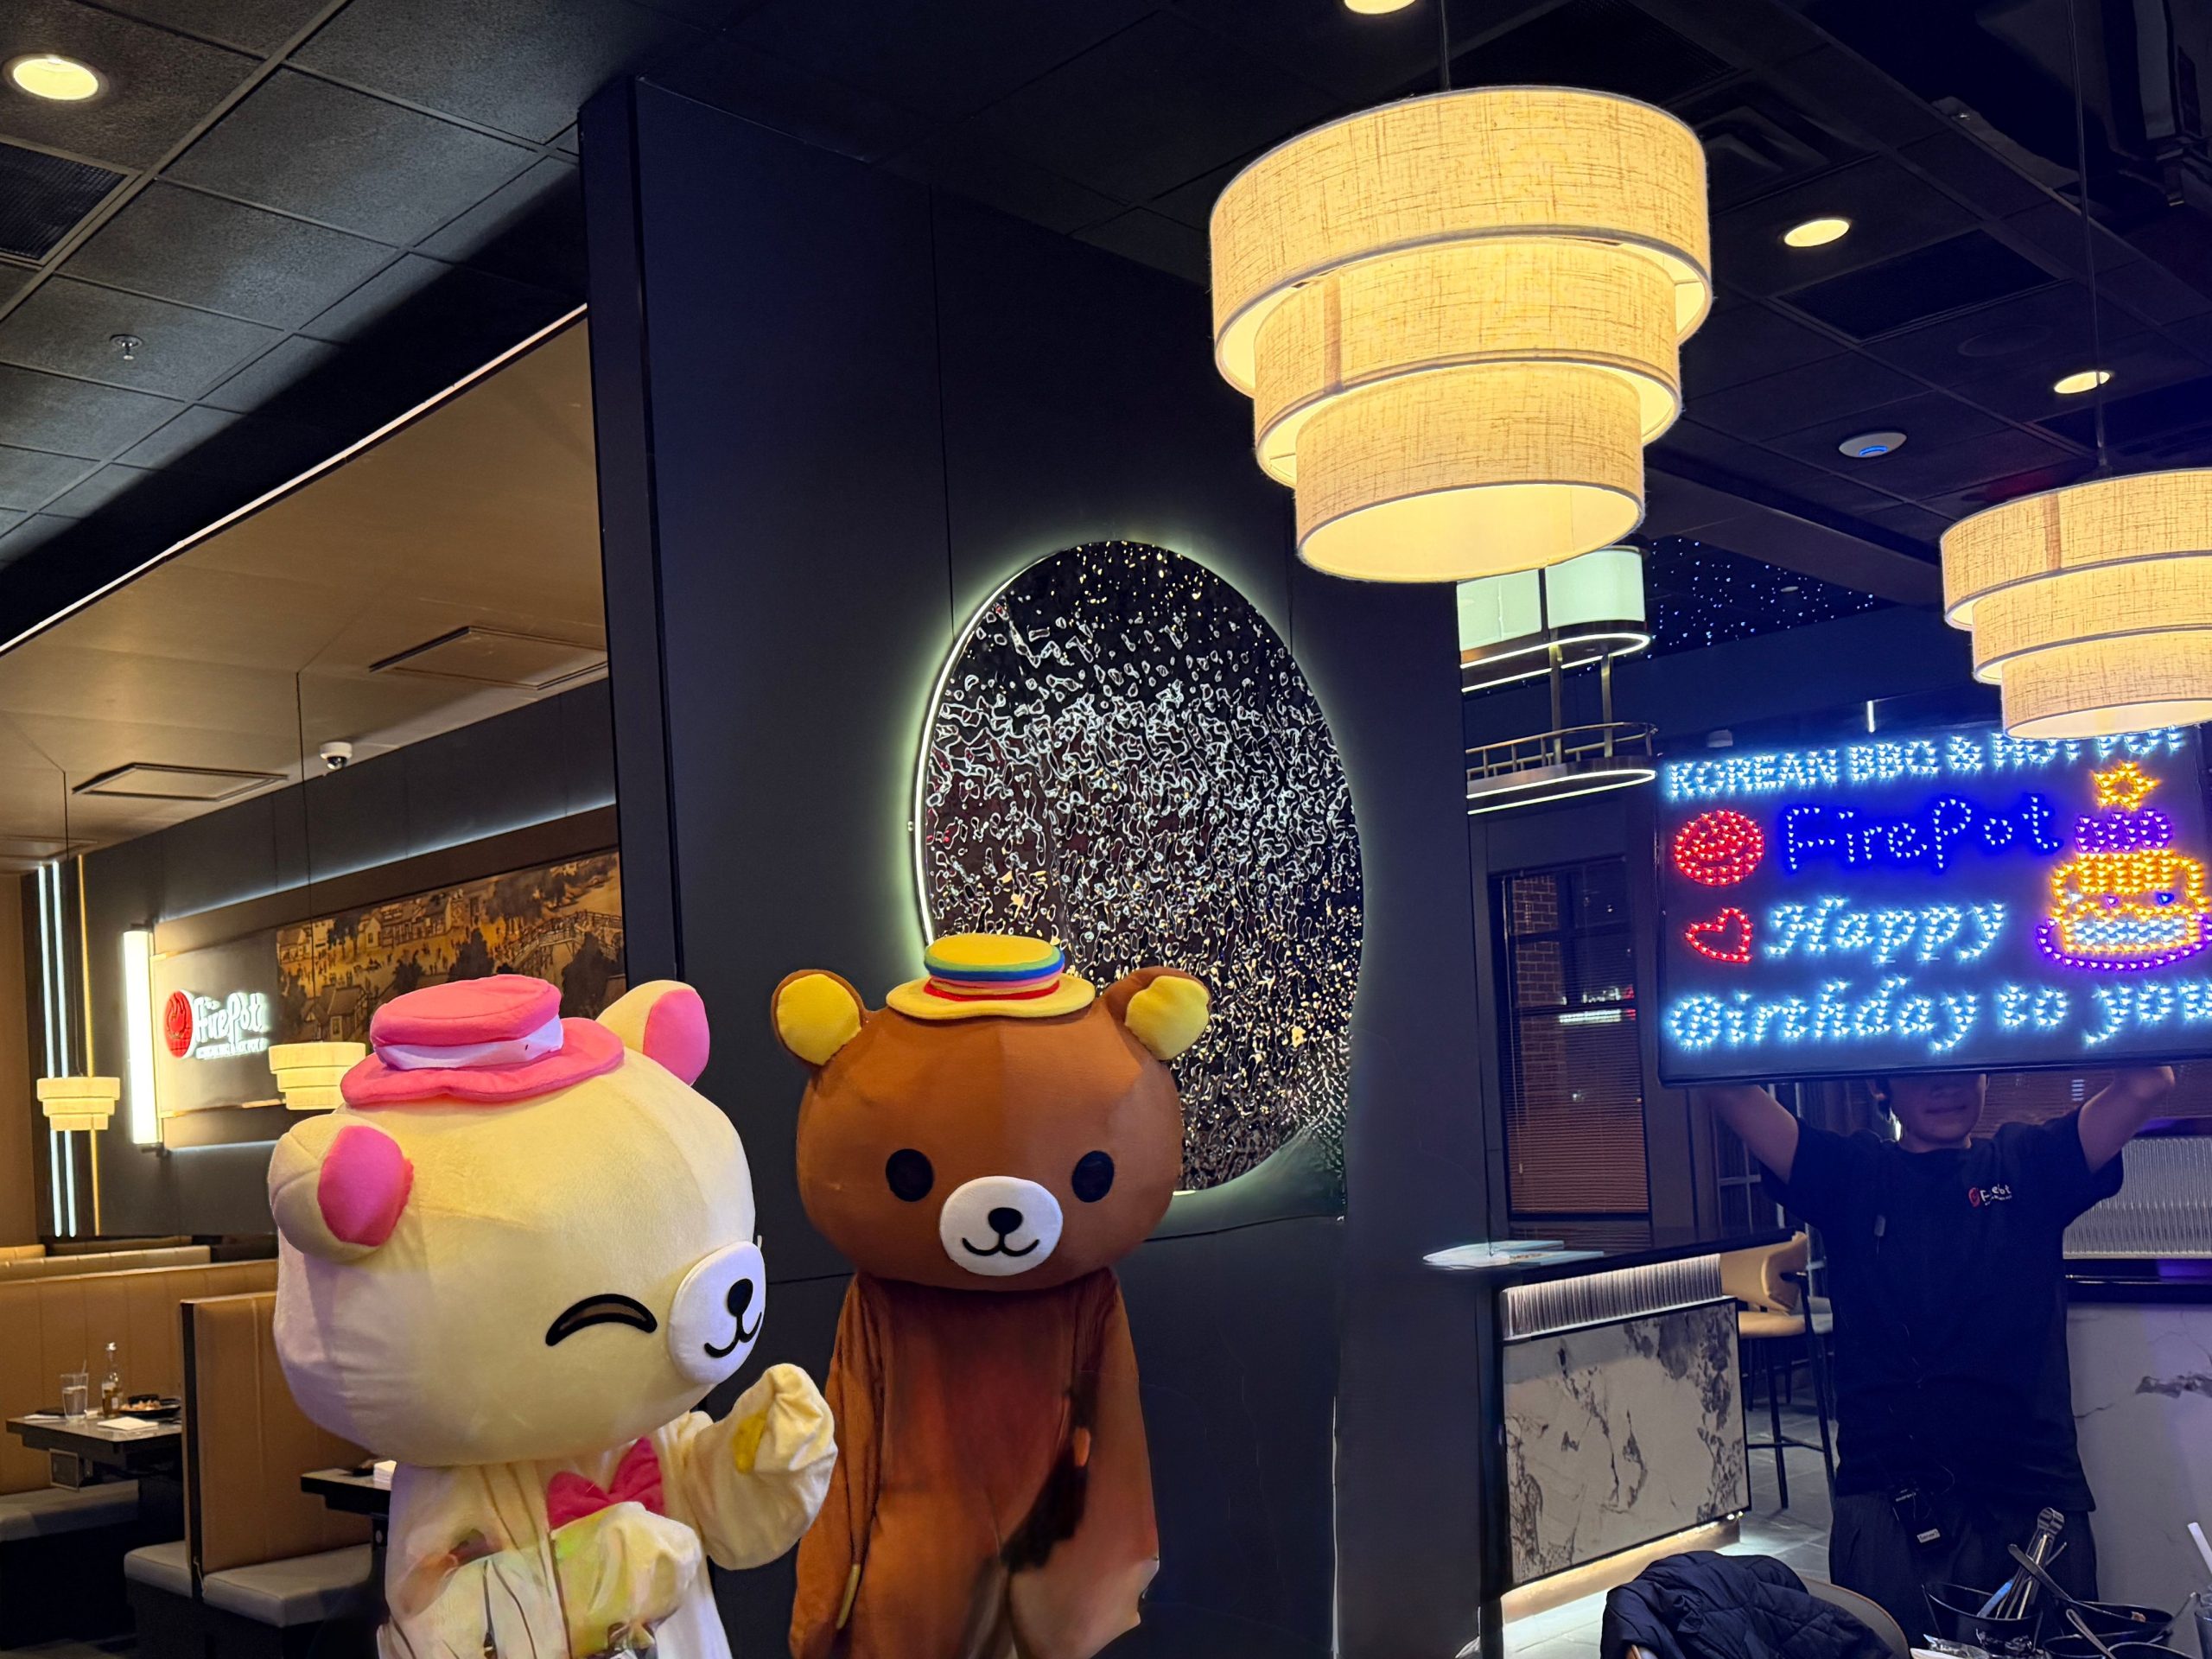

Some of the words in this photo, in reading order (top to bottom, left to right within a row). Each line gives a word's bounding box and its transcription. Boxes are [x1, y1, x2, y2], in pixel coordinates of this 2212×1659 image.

[1669, 748, 1840, 798] KOREAN
[1847, 741, 1941, 781] BBQ
[1948, 735, 1983, 772] &
[1784, 794, 2063, 871] FirePot
[1765, 895, 2007, 964] Happy
[1669, 975, 1978, 1050] Birthday
[1996, 982, 2069, 1028] to
[2082, 982, 2212, 1046] you
